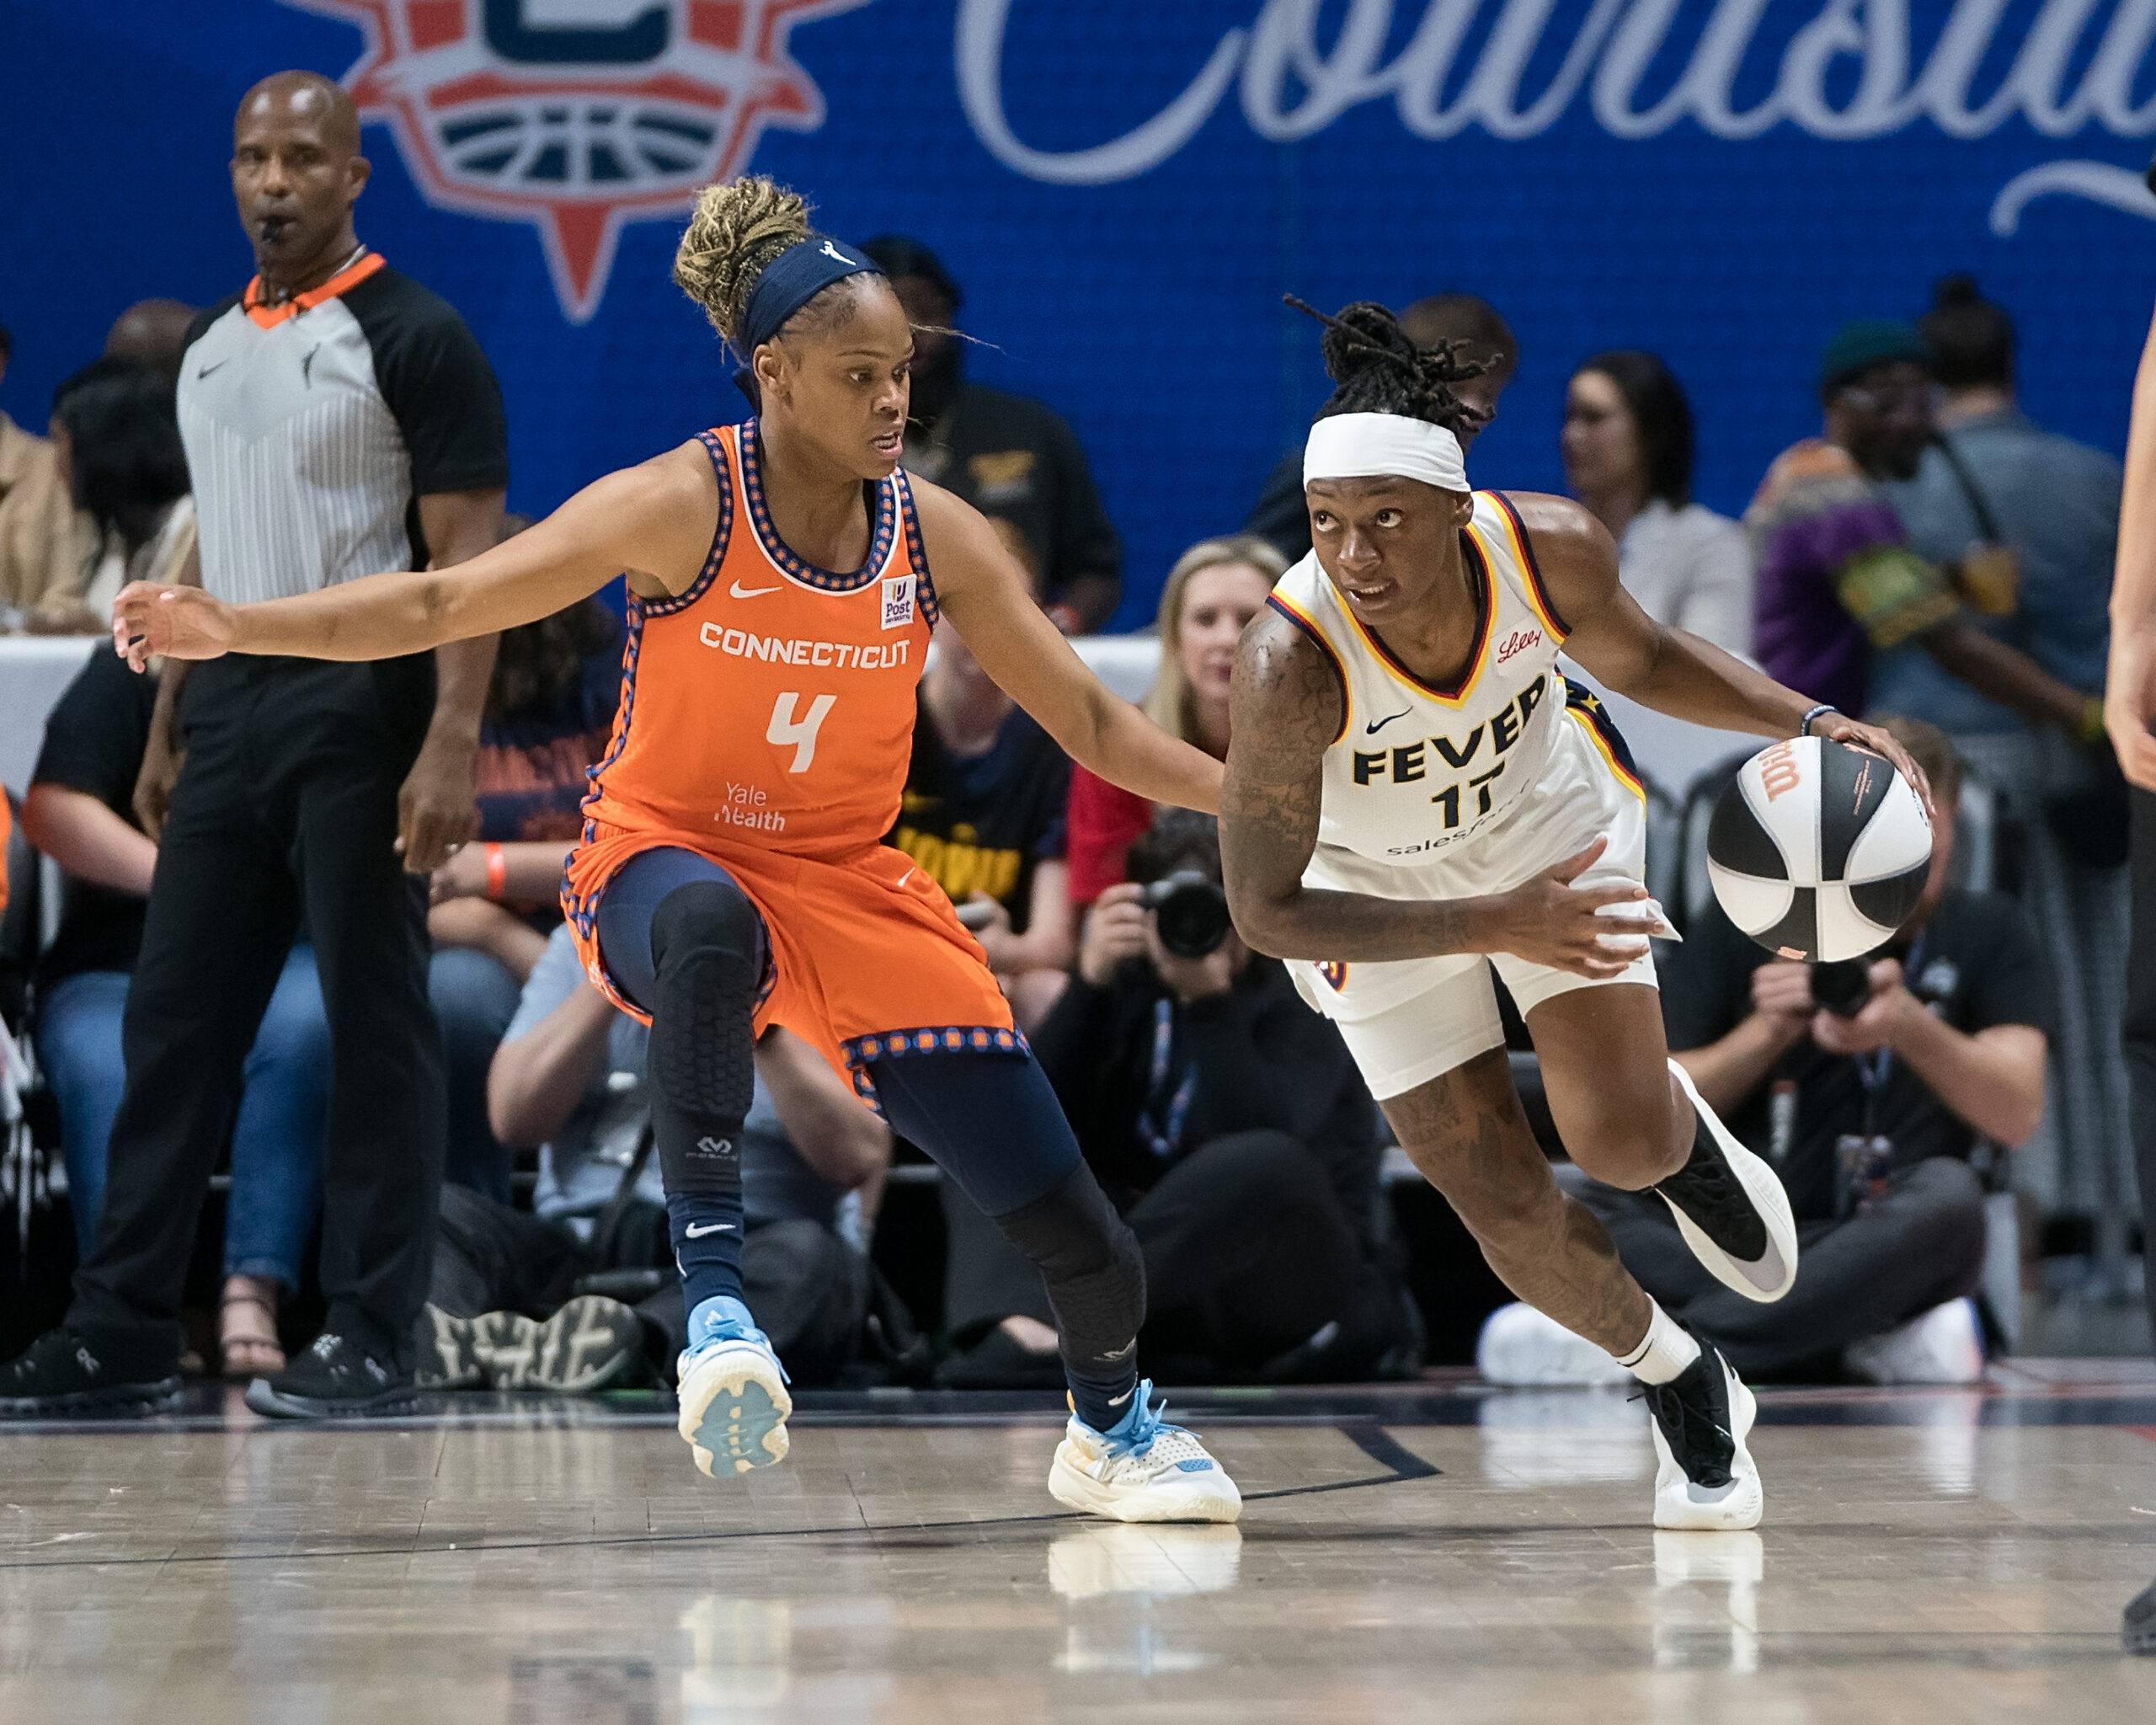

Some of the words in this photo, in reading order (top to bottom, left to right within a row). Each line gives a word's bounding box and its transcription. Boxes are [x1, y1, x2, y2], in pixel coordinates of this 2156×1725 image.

[886, 600, 911, 618] Post
[699, 621, 911, 670] CONNECTICUT
[1497, 629, 1543, 664] Lilly
[766, 692, 838, 773] 4
[726, 781, 767, 807] Yale
